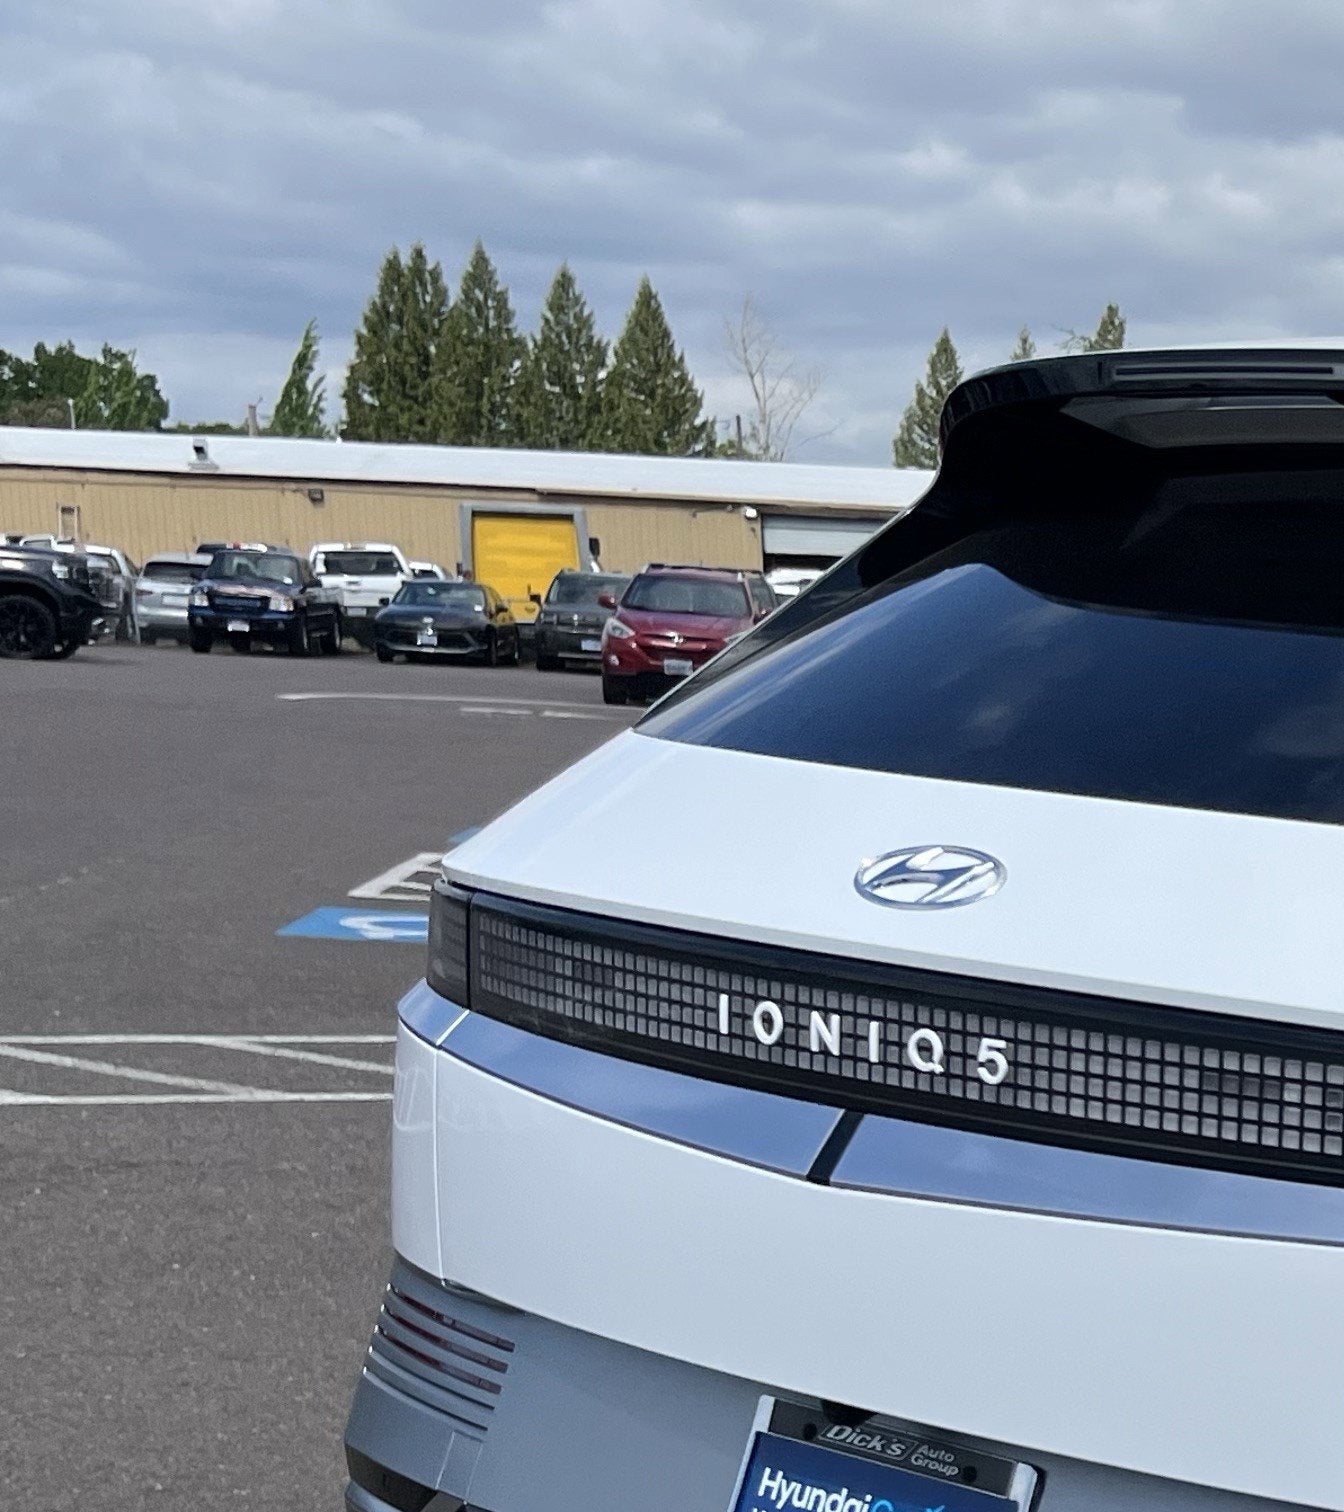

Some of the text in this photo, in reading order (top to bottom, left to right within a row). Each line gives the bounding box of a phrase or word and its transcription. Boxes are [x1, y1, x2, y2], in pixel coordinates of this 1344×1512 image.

[826, 1425, 907, 1456] Dick's
[910, 1453, 960, 1477] Group
[916, 1444, 956, 1463] Auto
